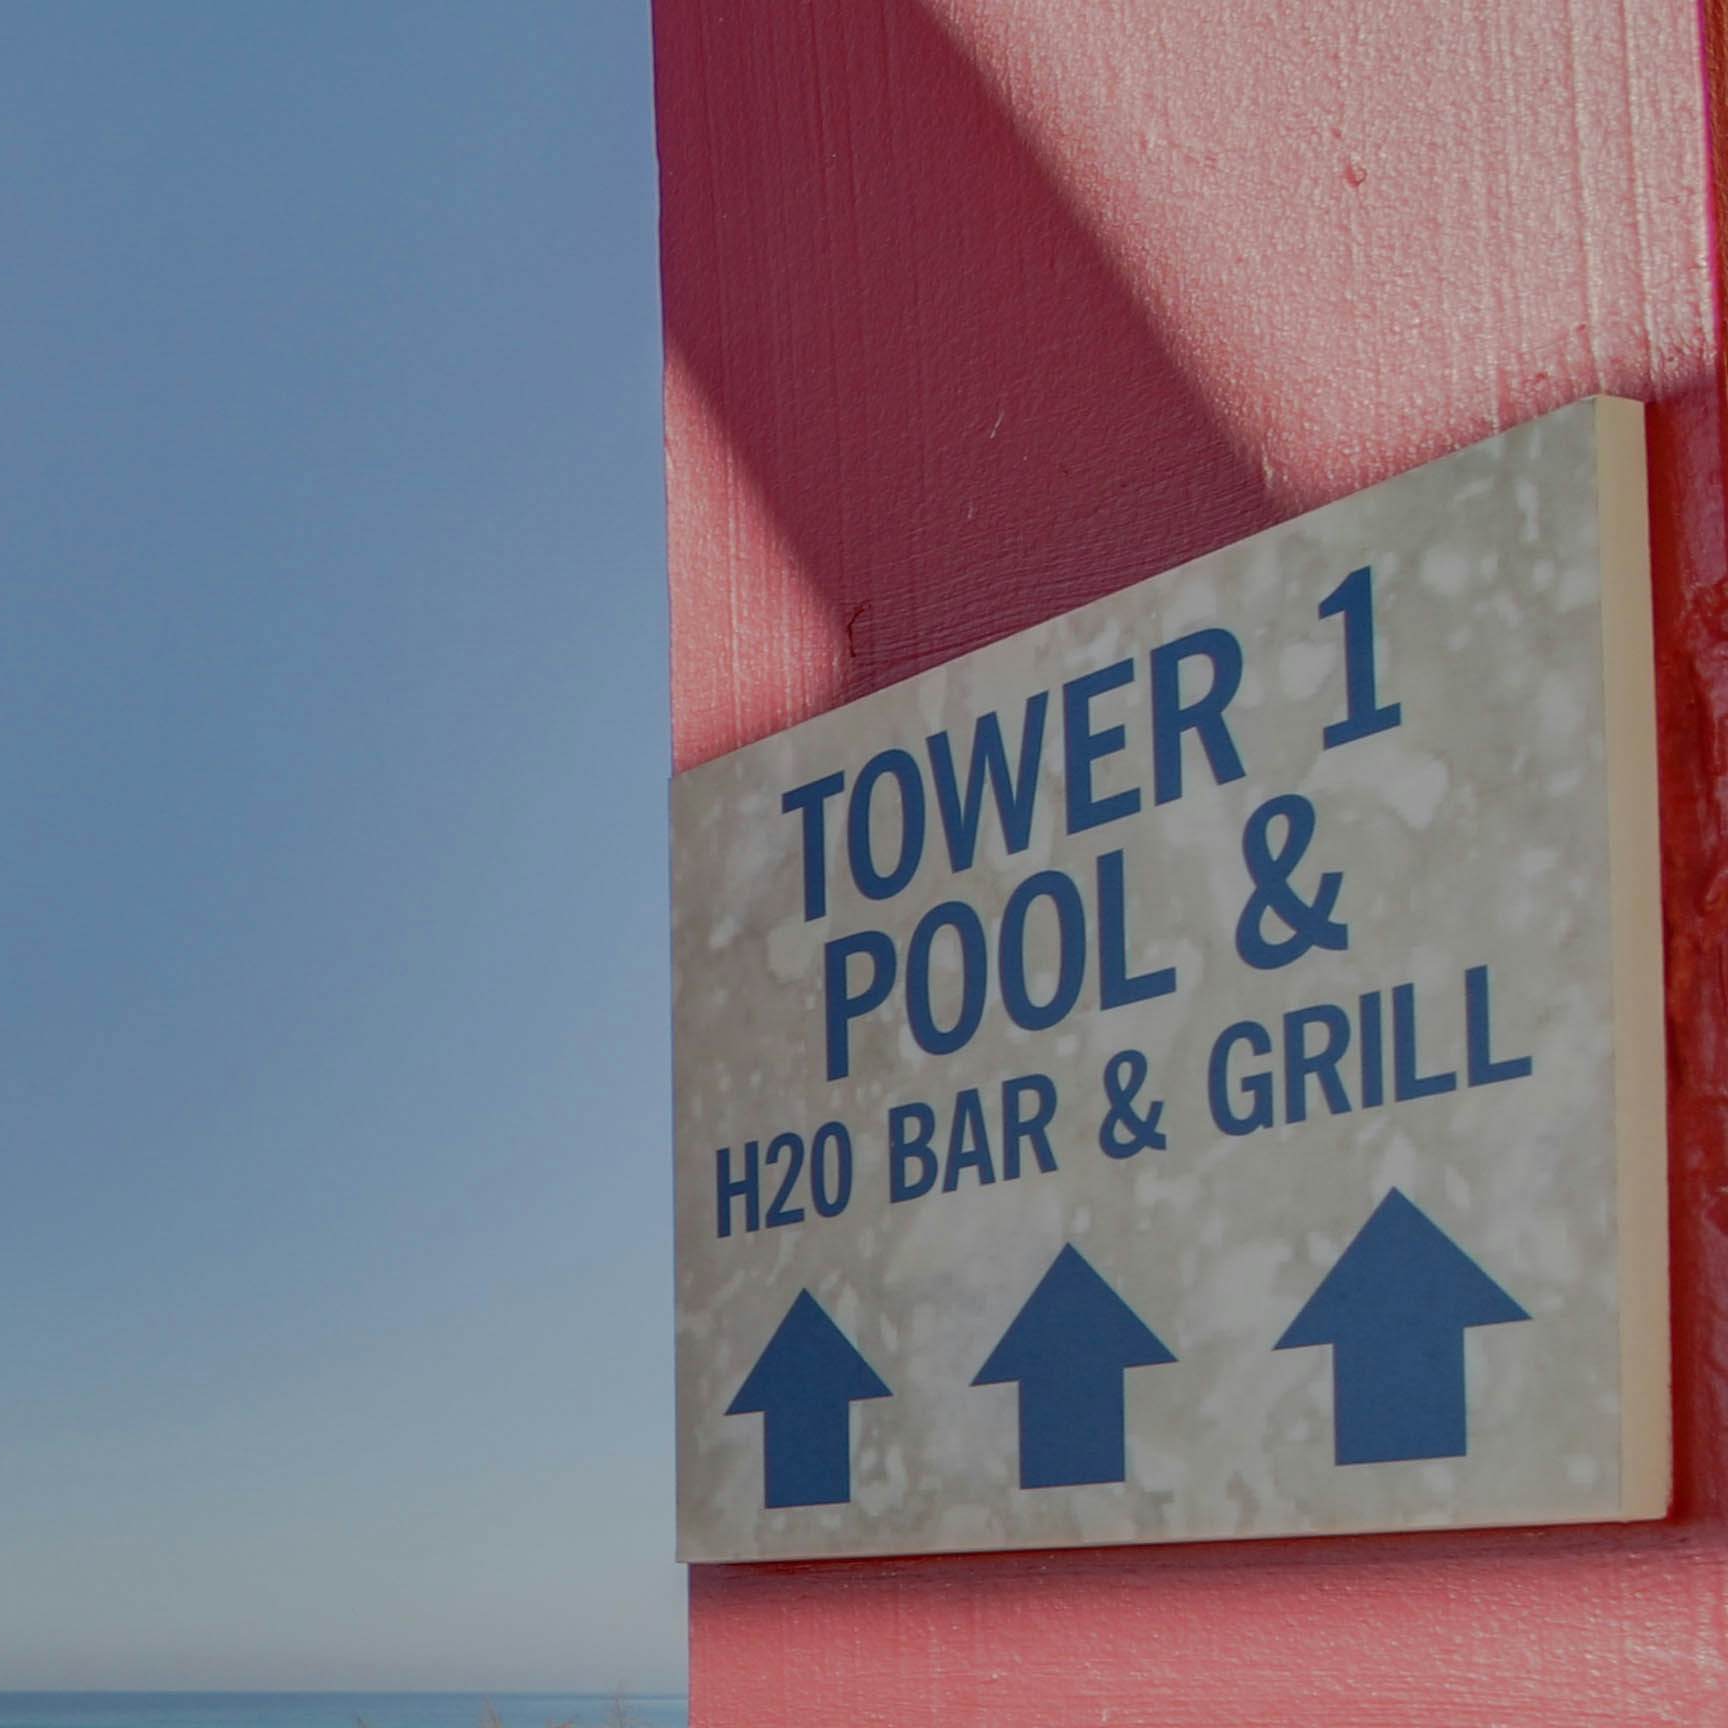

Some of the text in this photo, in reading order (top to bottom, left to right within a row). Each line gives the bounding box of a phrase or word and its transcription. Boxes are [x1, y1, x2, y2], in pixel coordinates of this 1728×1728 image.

[781, 565, 1402, 922] TOWER 1
[824, 793, 1348, 1081] POOL &
[888, 1073, 1059, 1204] BAR
[1098, 1048, 1168, 1160] &
[1207, 964, 1533, 1137] GRILL
